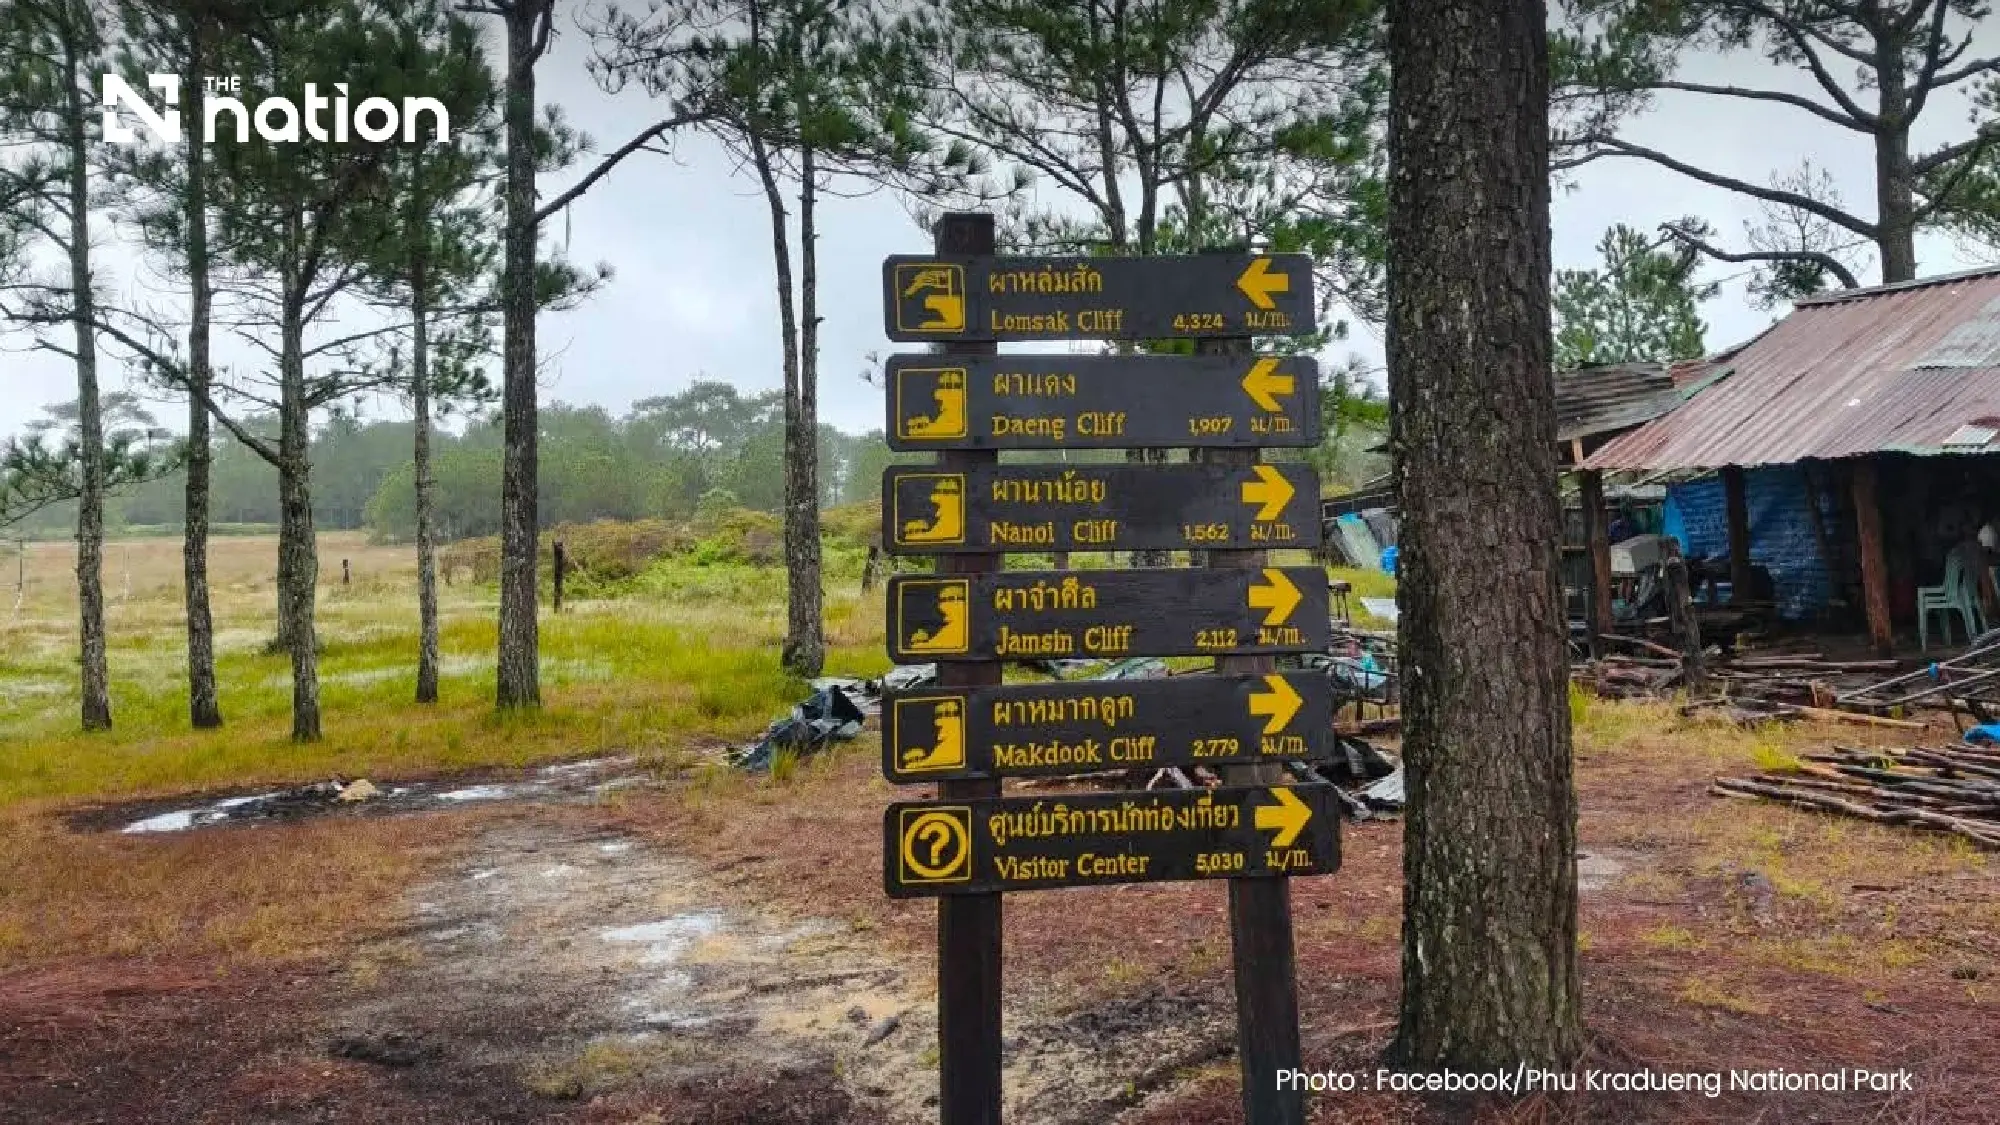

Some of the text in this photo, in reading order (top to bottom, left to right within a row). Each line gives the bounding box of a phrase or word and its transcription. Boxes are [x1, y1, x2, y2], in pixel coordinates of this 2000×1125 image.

[989, 264, 1103, 292] ผาหล่มสัก
[991, 310, 1068, 332] Lomsak
[1077, 309, 1124, 332] Cliff
[1172, 314, 1223, 331] 4,324
[993, 373, 1076, 395] ผาแดง
[992, 417, 1065, 438] Daeng
[1077, 412, 1126, 436] Cliff
[992, 471, 1105, 502] ผานาน้อย
[991, 522, 1054, 543] Nanoi
[1074, 520, 1118, 541] Cliff
[996, 627, 1072, 654] Jamsin
[1085, 626, 1131, 651] Cliff
[994, 695, 1133, 727] ผาหมากดูก
[993, 741, 1101, 768] Makdook
[1110, 737, 1156, 761] Cliff
[989, 797, 1240, 845] ศูนย์บริการนักท่องเที่ยว
[994, 857, 1069, 880] Visitor
[1077, 853, 1150, 877] Center
[1196, 852, 1244, 872] 5,030
